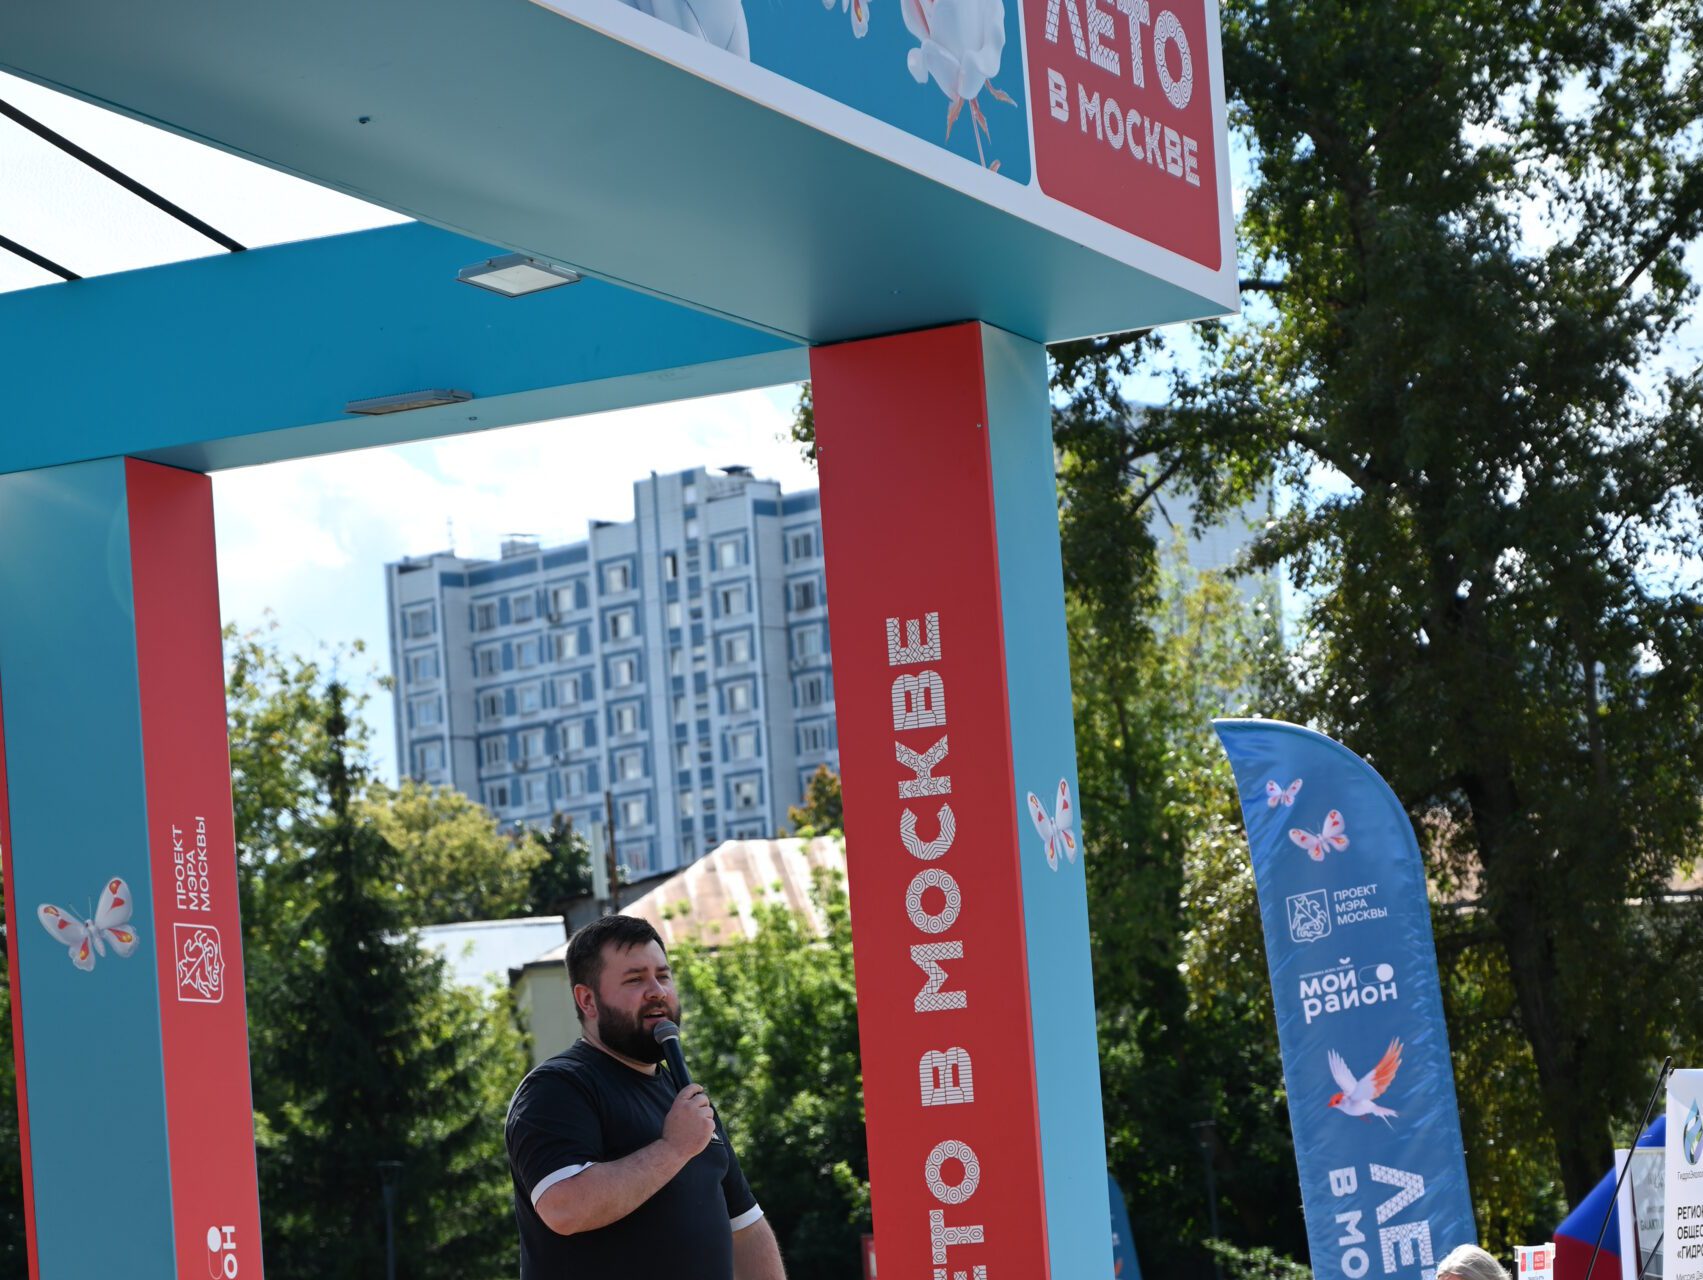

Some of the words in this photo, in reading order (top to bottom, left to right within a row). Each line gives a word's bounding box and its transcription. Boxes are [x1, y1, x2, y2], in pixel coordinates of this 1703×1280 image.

[1045, 0, 1193, 110] ЛЕТО
[1047, 67, 1069, 123] В
[1078, 83, 1201, 187] МОСКВЕ
[886, 612, 968, 1013] МОСКВЕ
[172, 824, 187, 910] ПРОЕКТ
[186, 850, 199, 910] МЭРА
[195, 816, 211, 911] МОСКВЫ
[1333, 884, 1378, 902] ПРОЕКТ
[1335, 898, 1368, 913] МЭРА
[1337, 907, 1387, 925] МОСКВЫ
[1300, 957, 1357, 999] мой
[919, 1046, 975, 1106] В
[1329, 1166, 1358, 1197] В
